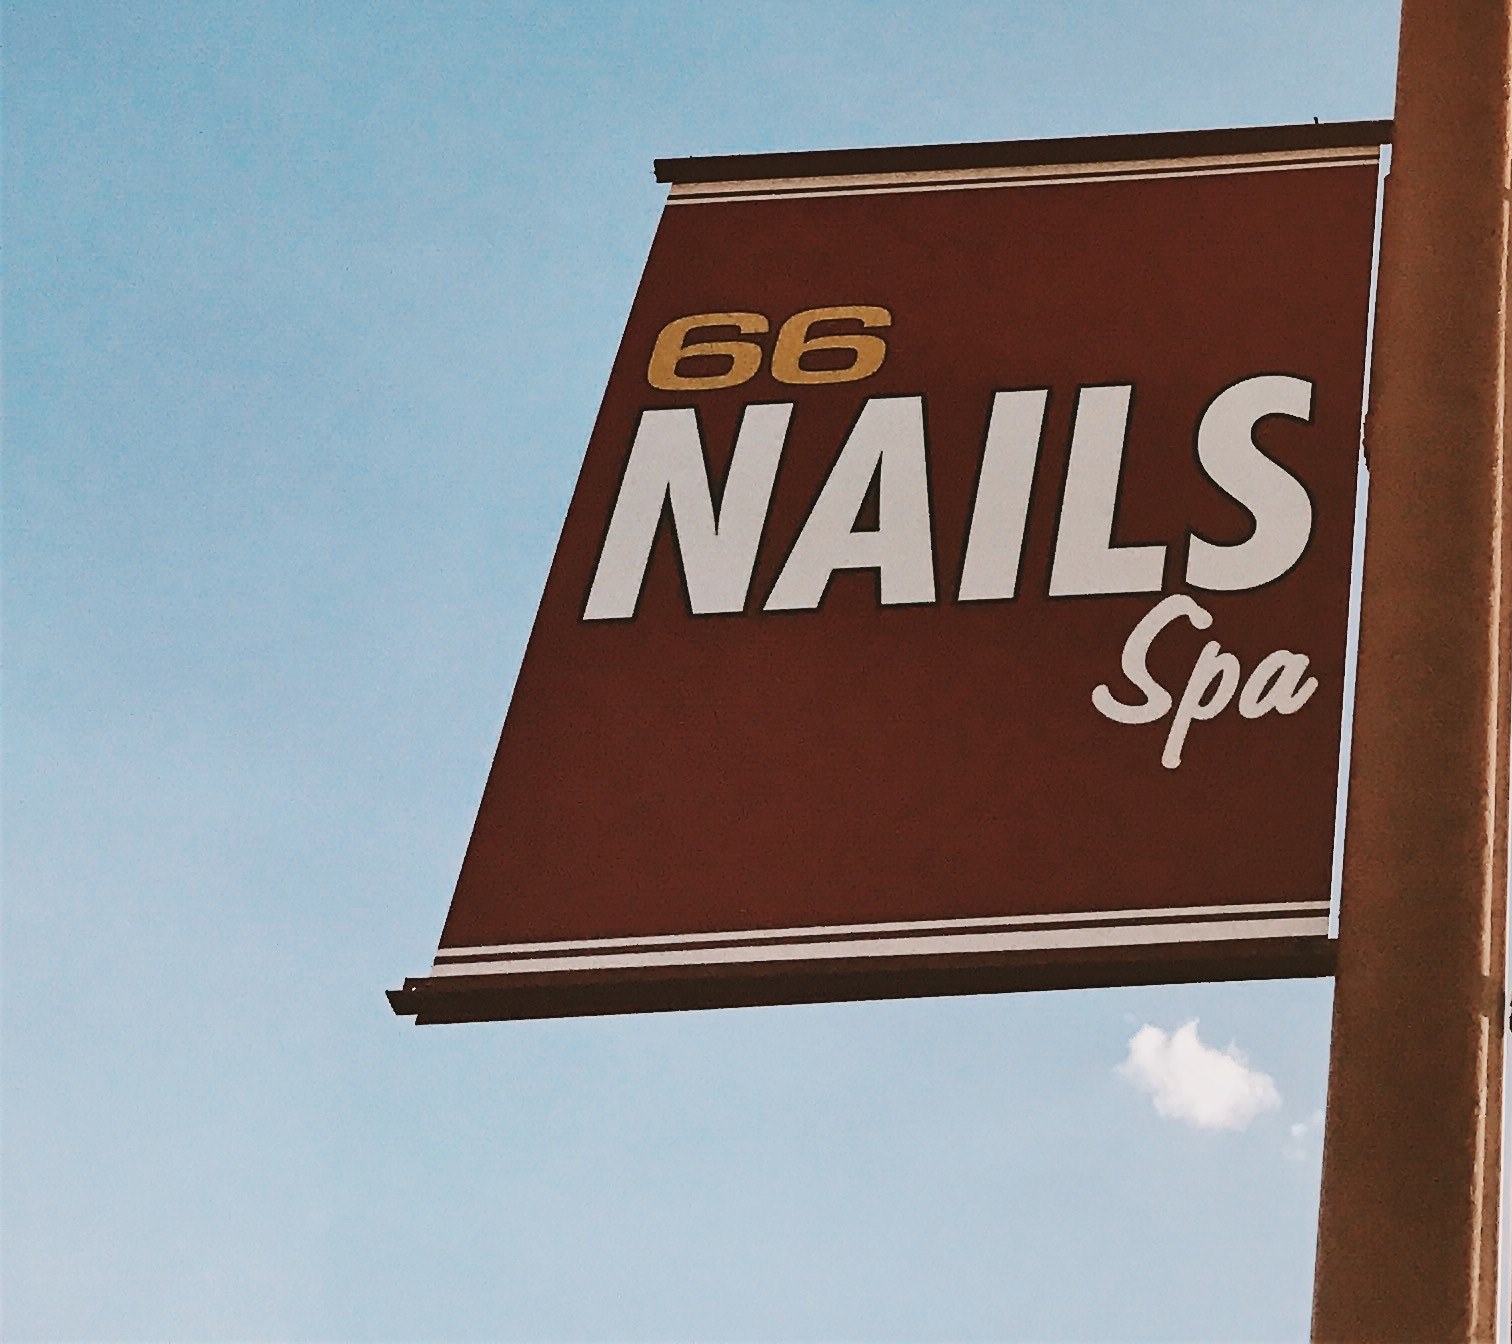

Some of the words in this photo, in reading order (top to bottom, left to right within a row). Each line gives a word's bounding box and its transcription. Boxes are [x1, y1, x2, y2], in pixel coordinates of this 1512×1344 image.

[646, 305, 892, 391] 66
[582, 375, 1314, 621] NAILS
[1091, 594, 1318, 769] Spa
